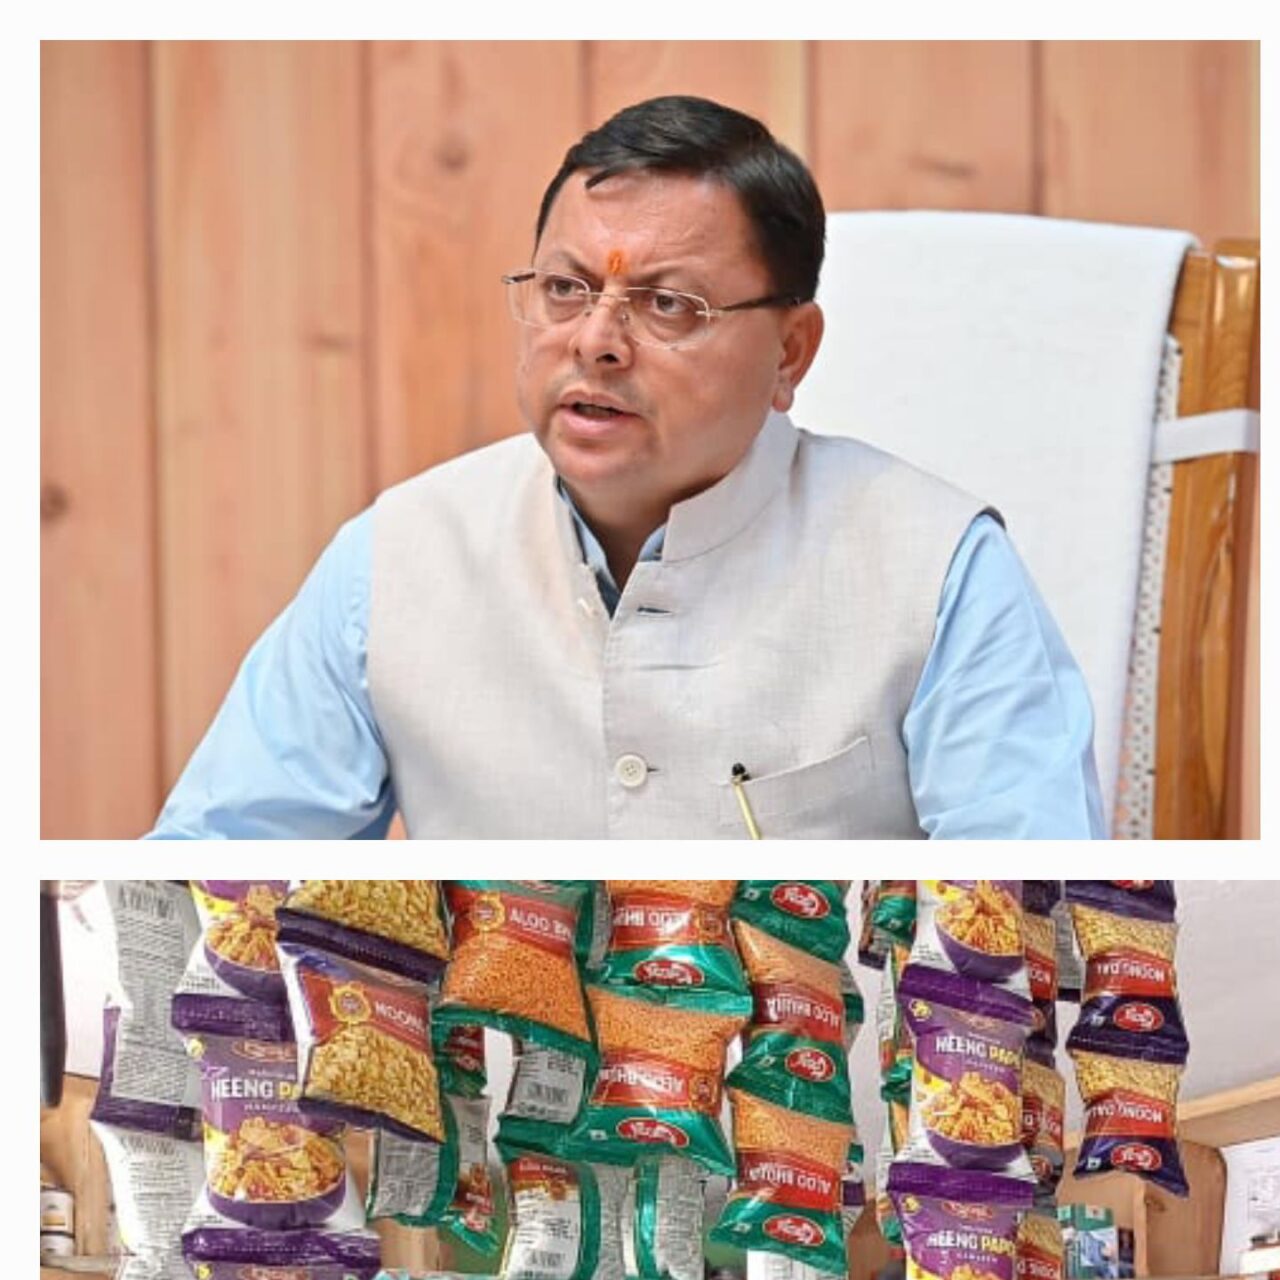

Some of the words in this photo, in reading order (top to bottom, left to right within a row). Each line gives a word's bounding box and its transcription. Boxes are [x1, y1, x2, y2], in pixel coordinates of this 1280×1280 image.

[510, 907, 549, 932] ALOO
[936, 1035, 986, 1058] HEENG
[211, 1077, 274, 1099] HEENG
[927, 1229, 979, 1251] HEENG
